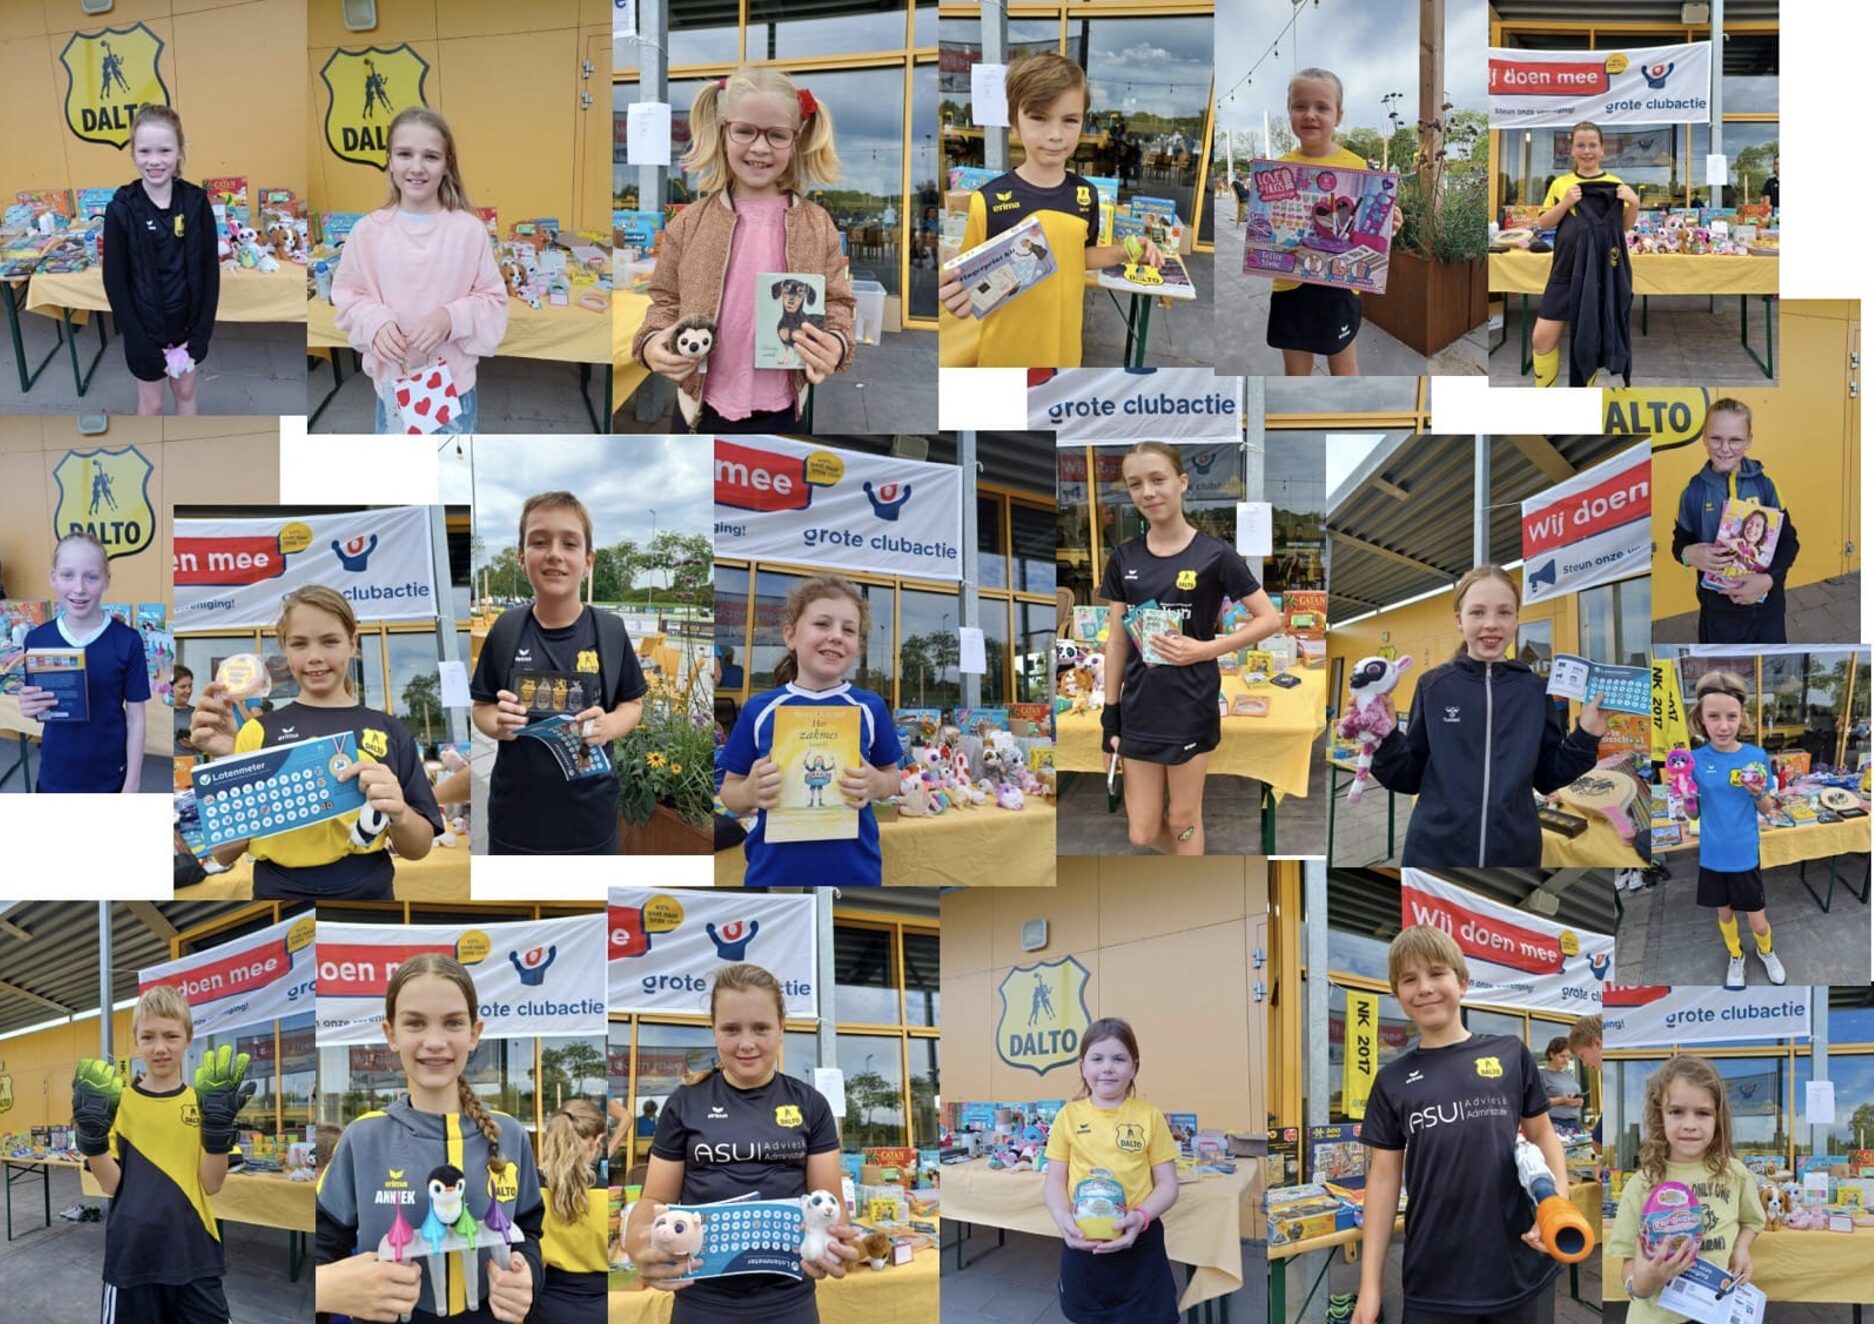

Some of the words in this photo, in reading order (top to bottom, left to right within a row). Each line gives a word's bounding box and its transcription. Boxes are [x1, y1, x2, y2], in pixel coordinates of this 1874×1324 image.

[1503, 68, 1551, 85] doen
[1556, 71, 1599, 85] mee
[1605, 99, 1642, 114] grote
[1646, 97, 1707, 110] clubactie
[81, 104, 138, 132] DALT
[342, 126, 388, 151] DAL
[992, 201, 1021, 212] erima
[1048, 396, 1116, 424] grote
[1123, 392, 1236, 416] clubactie
[714, 458, 793, 495] mee
[1528, 511, 1565, 542] Wij
[1573, 480, 1650, 526] doen
[803, 529, 863, 547] grote
[870, 534, 958, 559] clubactie
[208, 551, 270, 571] mee
[1563, 560, 1593, 574] Steun
[1595, 552, 1624, 566] onze
[1652, 667, 1663, 689] NK
[1652, 697, 1663, 729] 2017
[798, 728, 839, 741] zakmes
[212, 762, 266, 781] Lotenmeter
[1459, 921, 1514, 952] doen
[1518, 940, 1558, 963] mee
[229, 956, 279, 985] mee
[642, 973, 707, 995] grote
[1562, 986, 1588, 1000] grote
[517, 998, 605, 1017] clubactie
[1357, 1000, 1370, 1027] NK
[1666, 1008, 1715, 1027] grote
[1721, 1001, 1806, 1021] clubactie
[322, 1018, 350, 1028] onze
[1010, 1028, 1078, 1057] DALTO
[1357, 1035, 1371, 1075] 2017
[1408, 1101, 1458, 1133] ASU
[694, 1141, 757, 1163] ASU
[1120, 1139, 1143, 1149] DALTO
